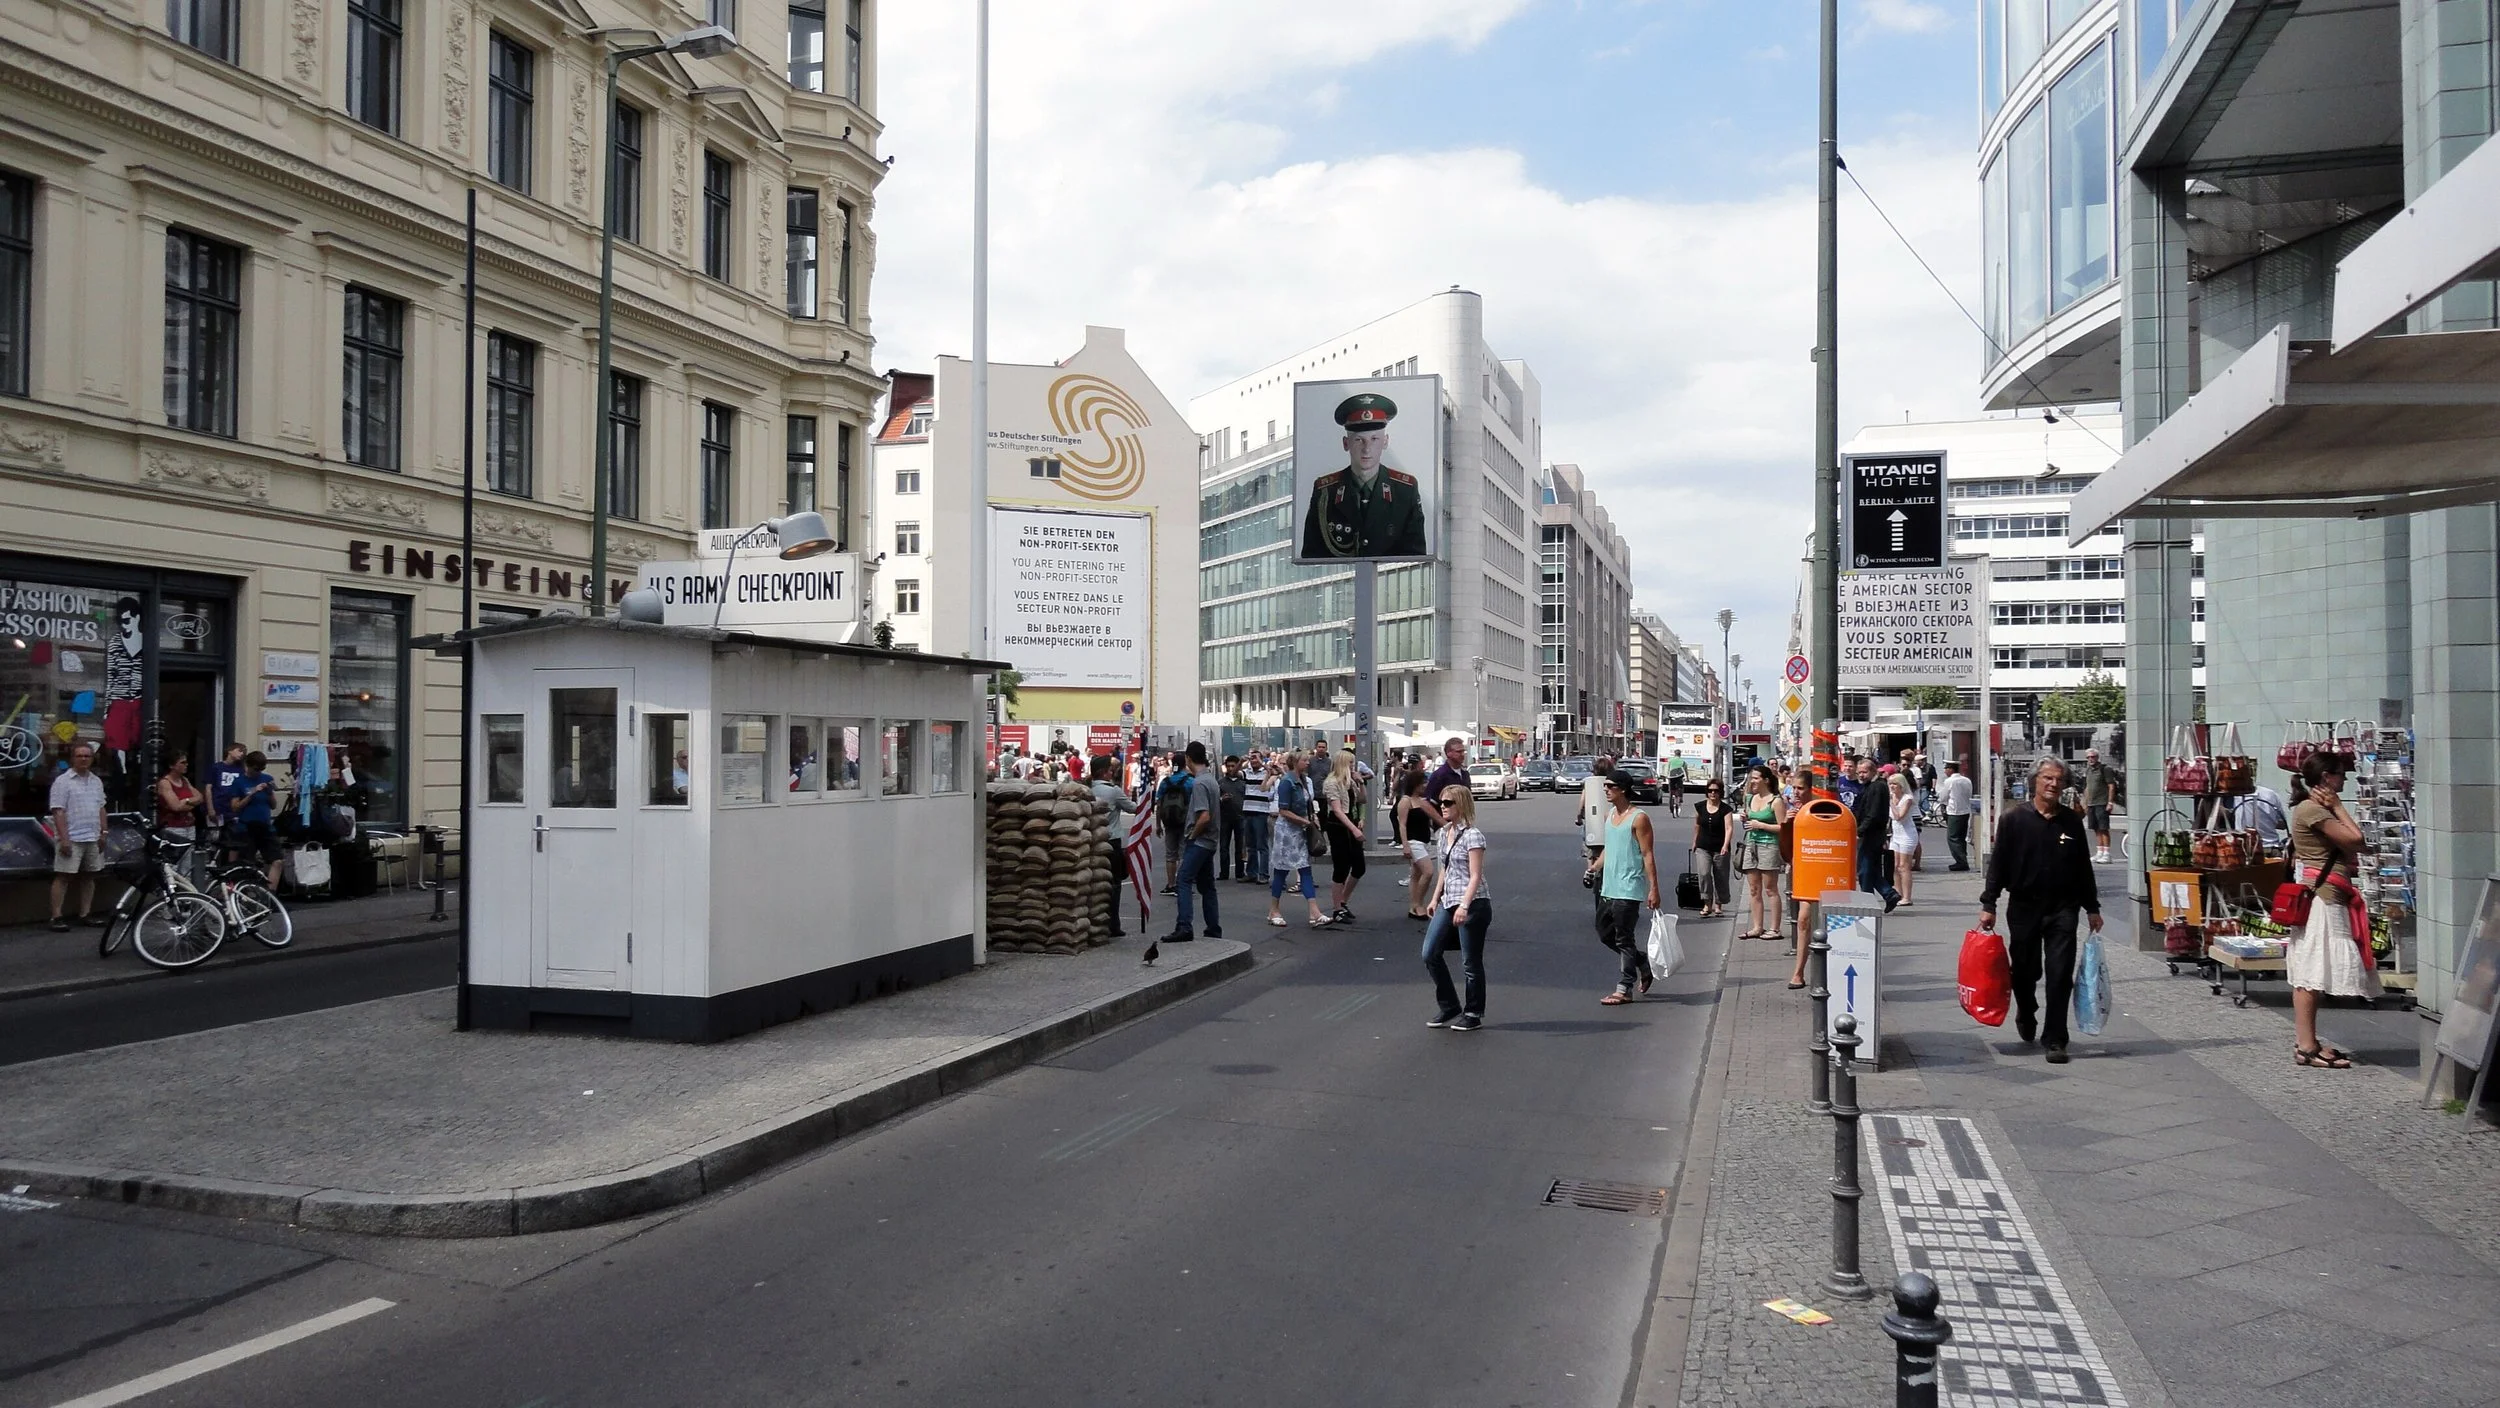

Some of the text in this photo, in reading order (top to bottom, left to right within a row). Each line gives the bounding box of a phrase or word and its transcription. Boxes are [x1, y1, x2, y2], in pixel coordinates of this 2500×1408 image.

[1000, 431, 1040, 442] Deutscher
[1041, 435, 1082, 445] Stiftungen
[1857, 463, 1937, 477] TITANIC
[1865, 476, 1932, 487] HOTEL
[1859, 498, 1894, 506] BERLIN
[1904, 496, 1936, 504] MITTE
[1023, 526, 1115, 540] SIE BETRETEN DEN
[711, 534, 734, 550] ALLIED
[1019, 538, 1120, 553] NON-PROFIT-SEKTOR
[1012, 558, 1126, 572] YOU ARE ENTERING THE
[1020, 571, 1119, 584] NON-PROFIT-SECTOR
[683, 575, 730, 604] ARMY
[738, 571, 844, 603] CHECKPOINT
[1853, 584, 1917, 596] AMERICAN
[1925, 583, 1973, 595] SECTOR
[1, 587, 90, 615] FASHION
[1014, 590, 1124, 604] VOUS ENTREZ DANS LE
[1017, 603, 1121, 616] SECTEUR NON-PROFIT
[1855, 600, 1941, 613] ВЫЕЗЖАЕТЕ
[1950, 599, 1969, 611] ИЗ
[1840, 615, 1973, 628] ЕРИКАНСКОГО СЕКТОРА
[1004, 635, 1132, 651] некоммерческий сектор
[1846, 632, 1948, 644] VOUS SORTEZ
[1845, 648, 1899, 659] SECTEUR
[1838, 665, 1973, 674] ERLASSEN DEN AMERIKANISCHEN SEKTOR
[278, 684, 301, 694] WSP
